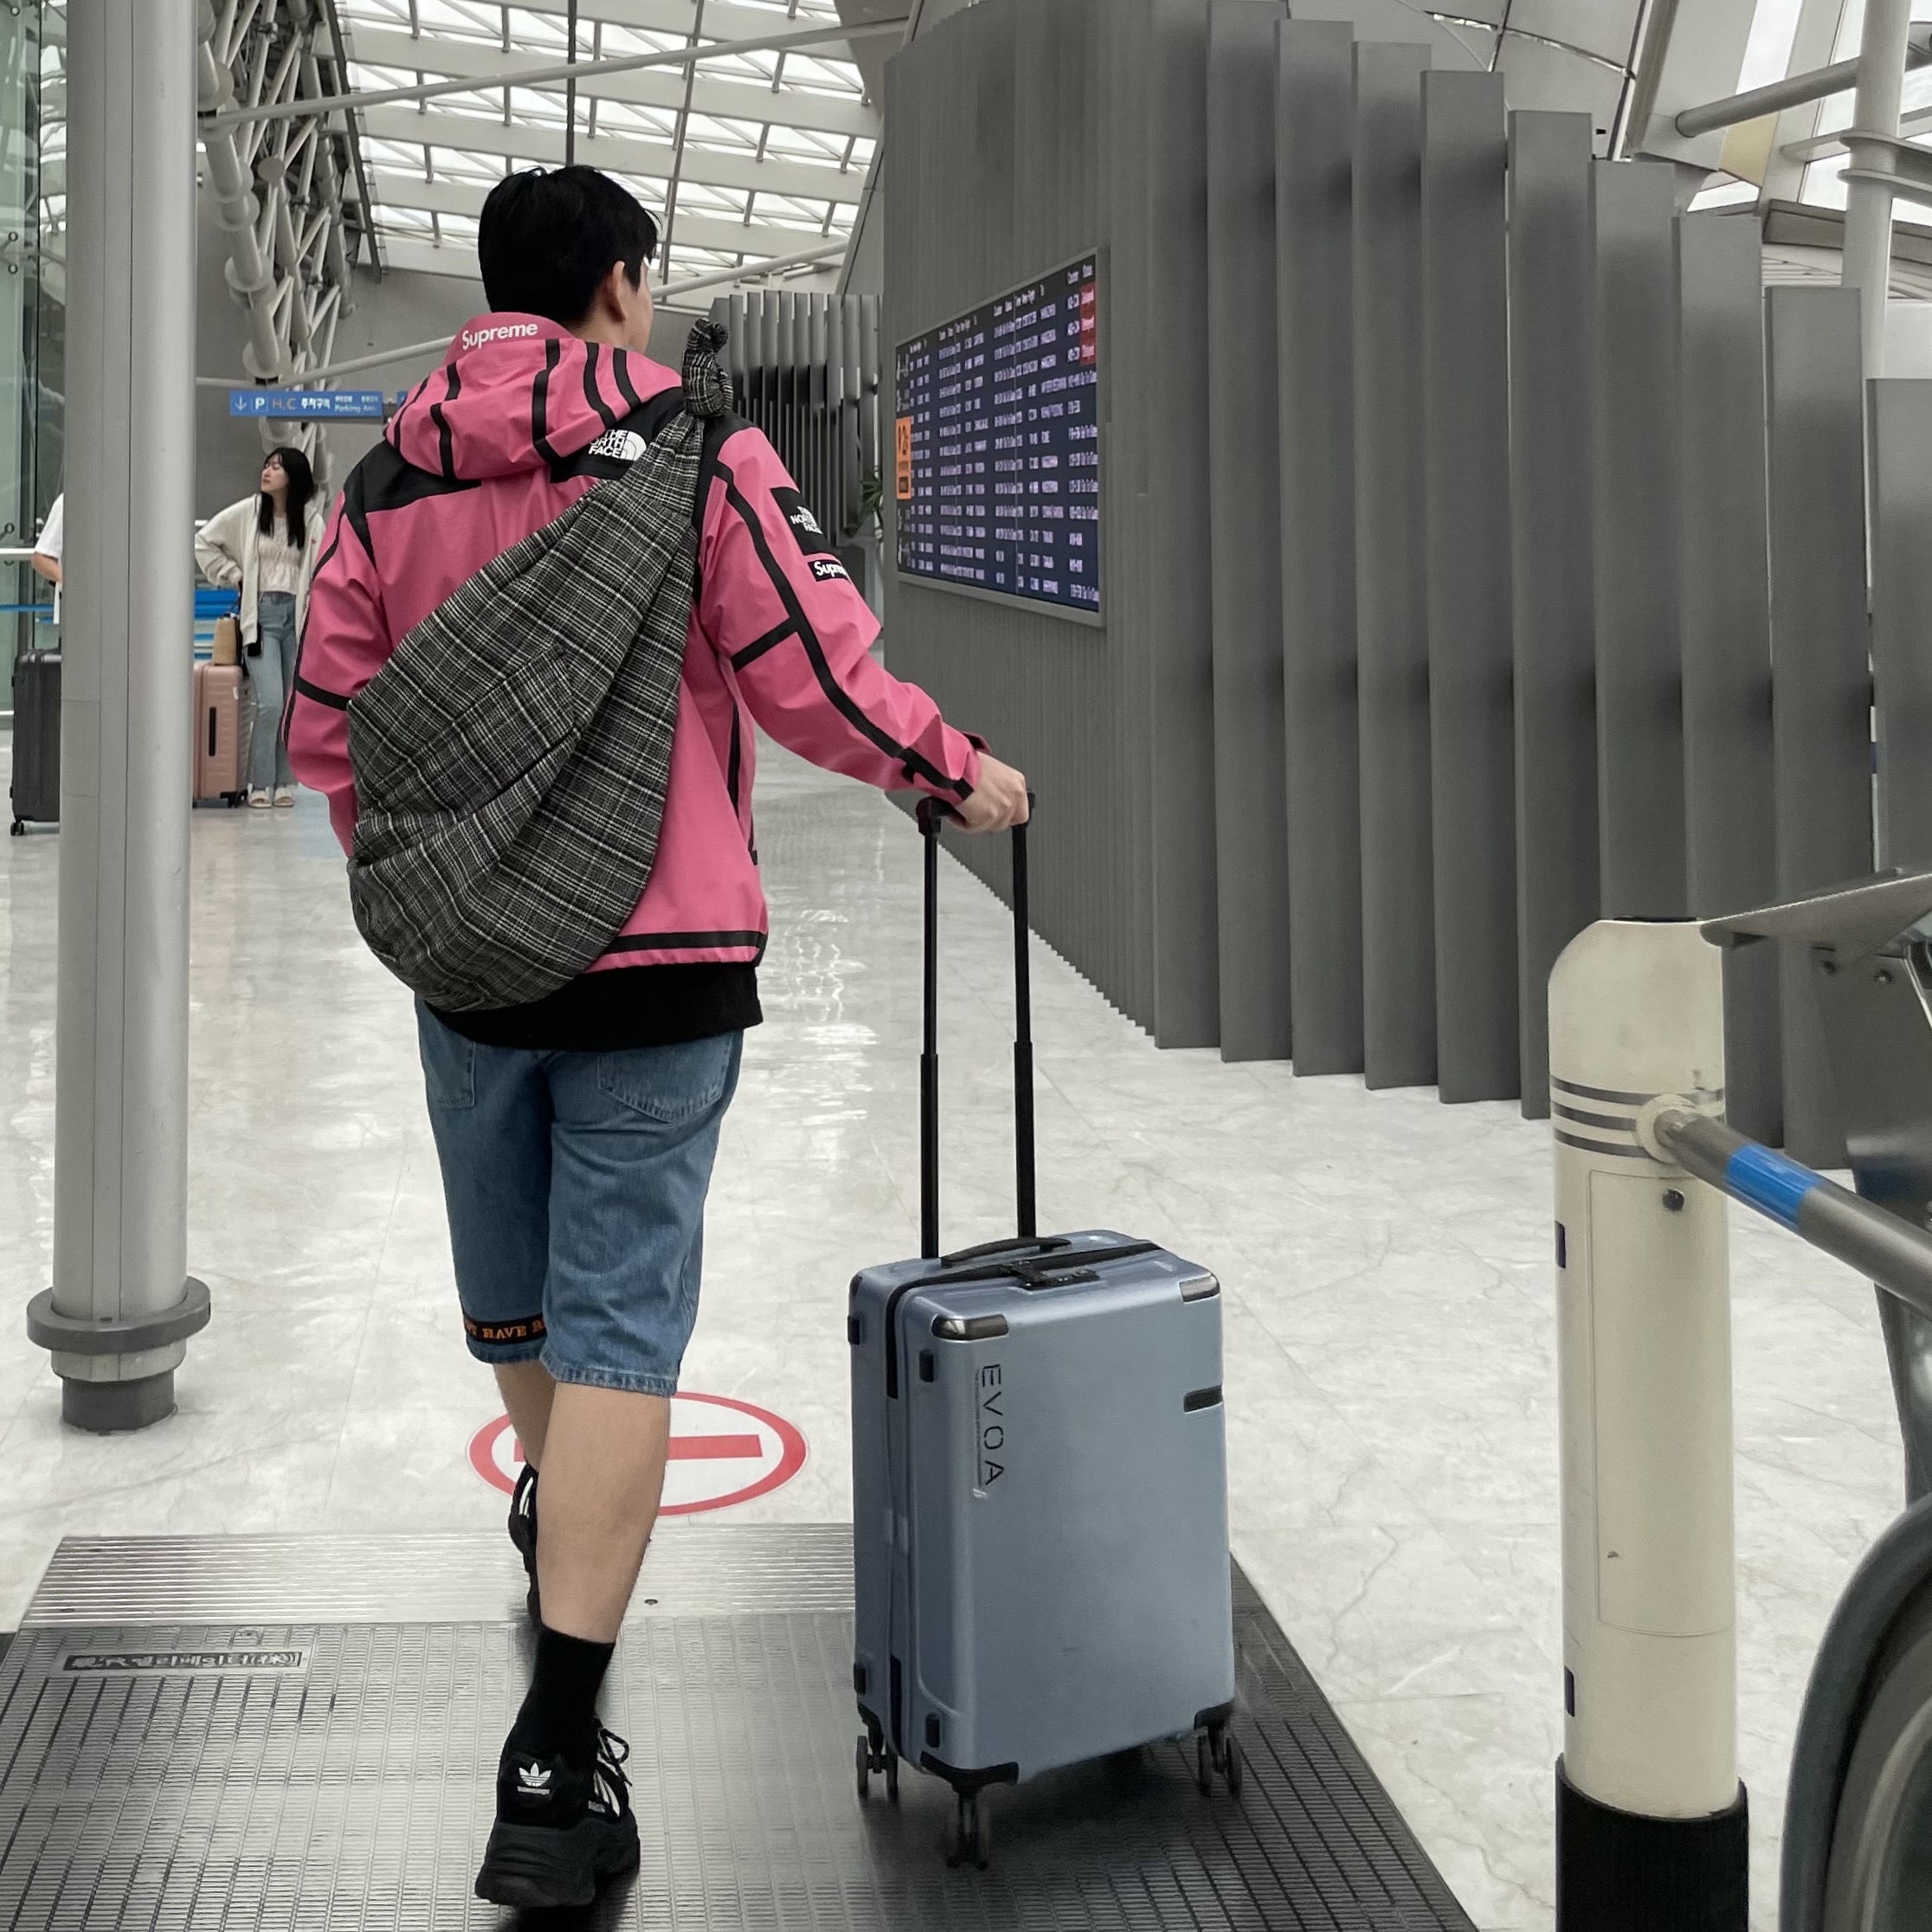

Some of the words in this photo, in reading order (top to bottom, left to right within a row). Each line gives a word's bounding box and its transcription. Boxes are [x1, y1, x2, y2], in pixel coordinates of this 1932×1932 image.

[461, 323, 538, 351] Supreme
[254, 397, 266, 410] P
[588, 445, 623, 460] FACE
[982, 1363, 1005, 1487] EVOA
